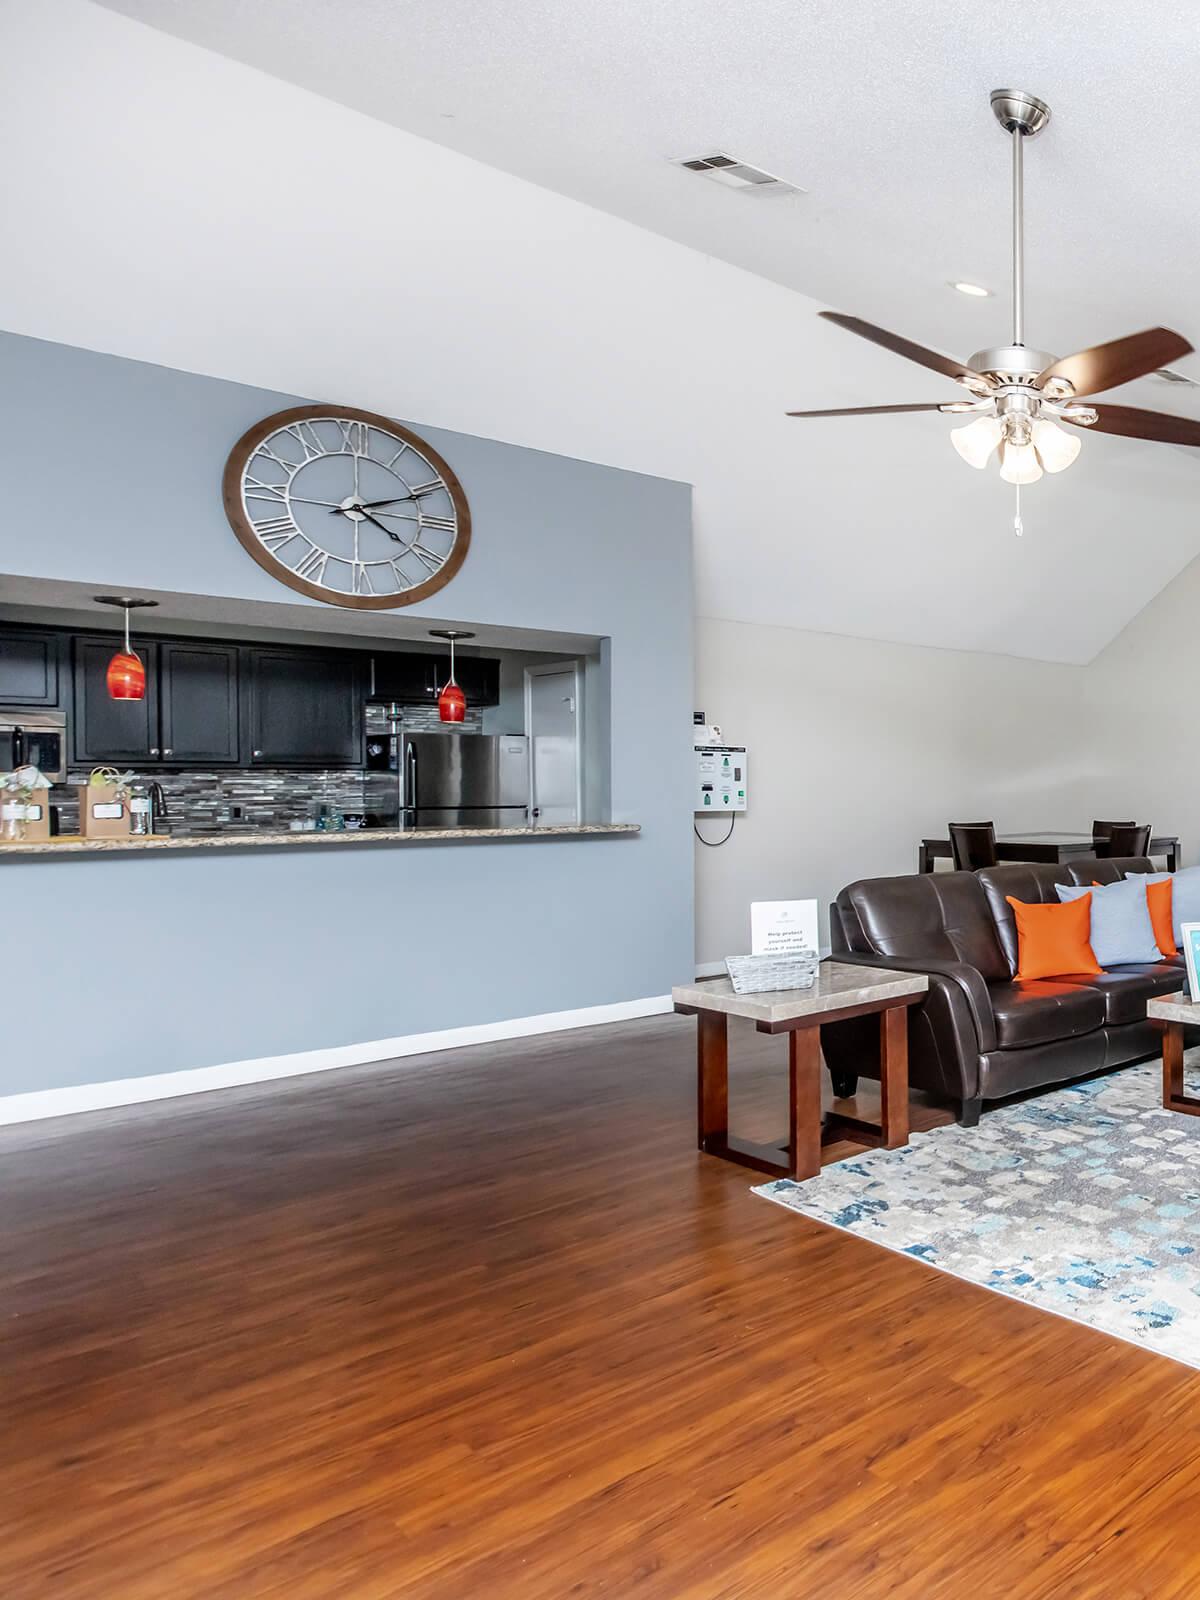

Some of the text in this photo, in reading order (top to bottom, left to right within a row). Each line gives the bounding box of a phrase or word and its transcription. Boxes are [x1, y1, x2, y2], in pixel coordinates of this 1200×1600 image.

[285, 421, 327, 460] XI
[336, 420, 368, 456] XII
[255, 443, 301, 477] X
[244, 474, 290, 503] IX
[252, 515, 301, 552] VIII
[419, 513, 456, 532] III
[292, 547, 329, 585] VII
[351, 562, 375, 595] VI
